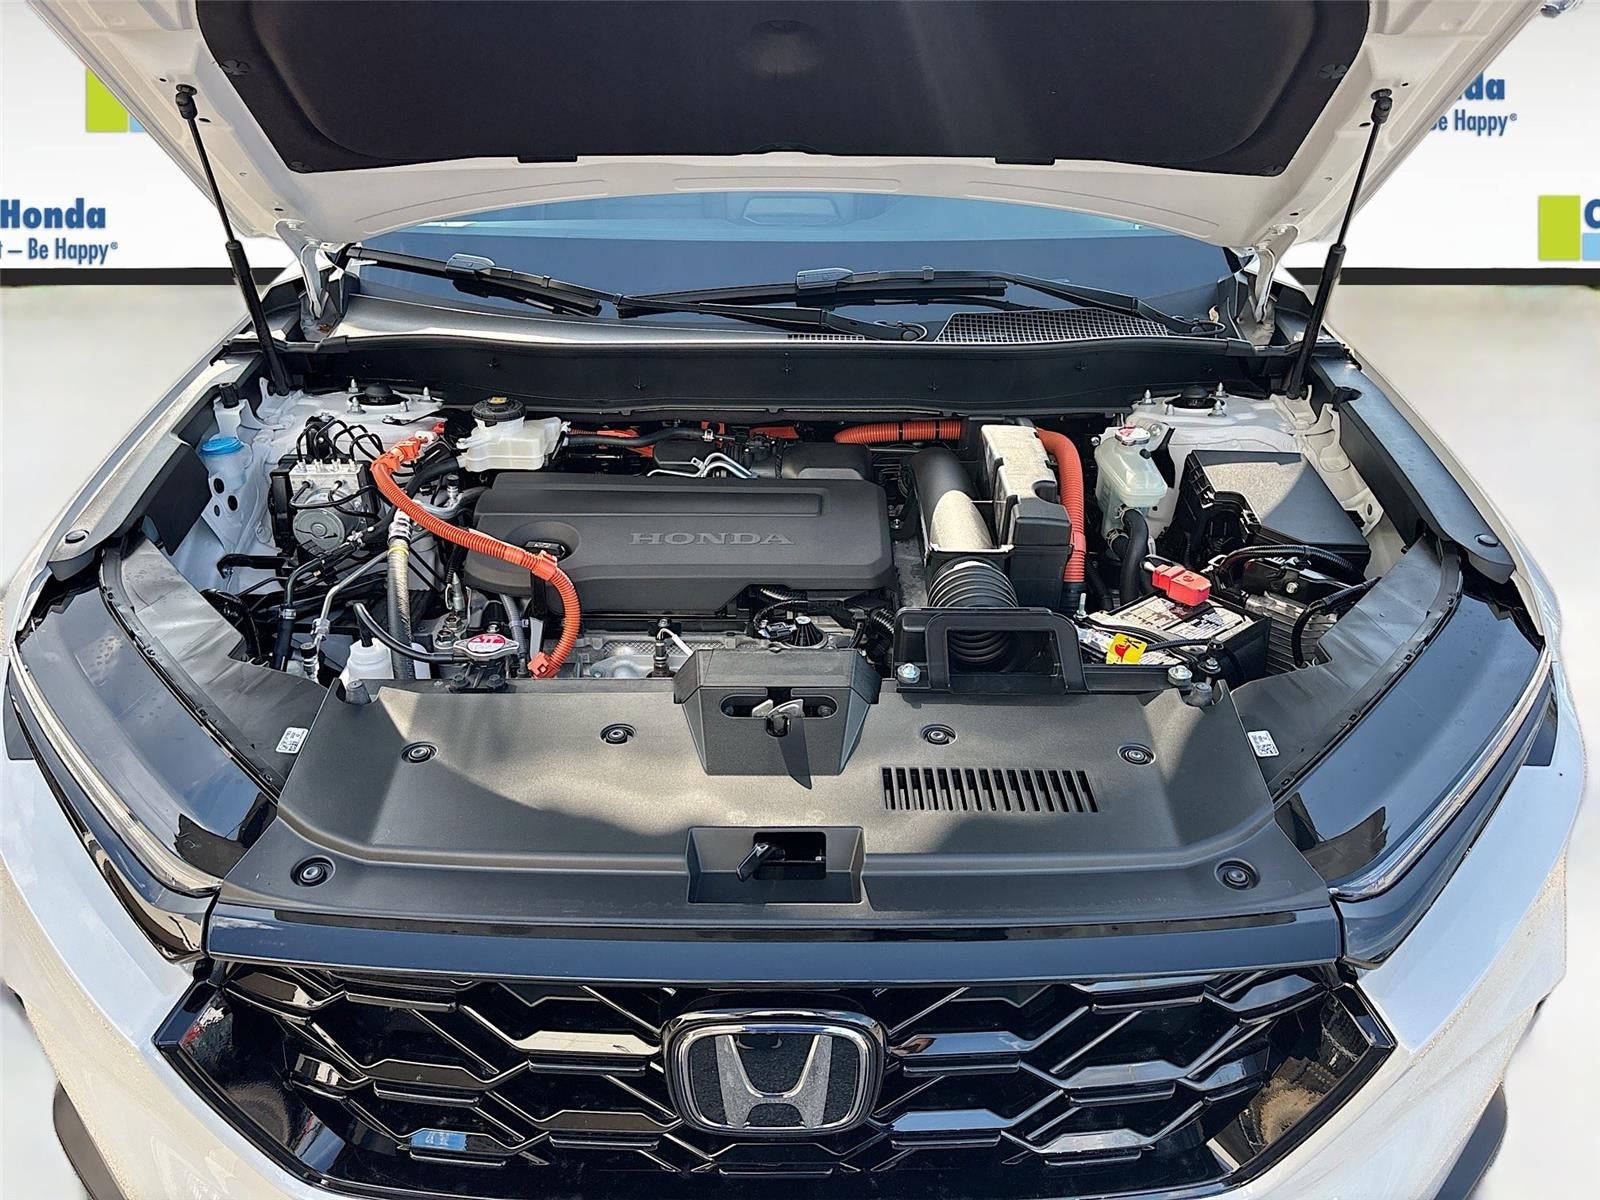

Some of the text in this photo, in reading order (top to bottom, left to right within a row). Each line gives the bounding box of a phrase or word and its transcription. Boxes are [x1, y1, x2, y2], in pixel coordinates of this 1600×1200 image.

[0, 197, 106, 229] Honda
[28, 237, 49, 260] Be
[629, 532, 796, 545] HONDA
